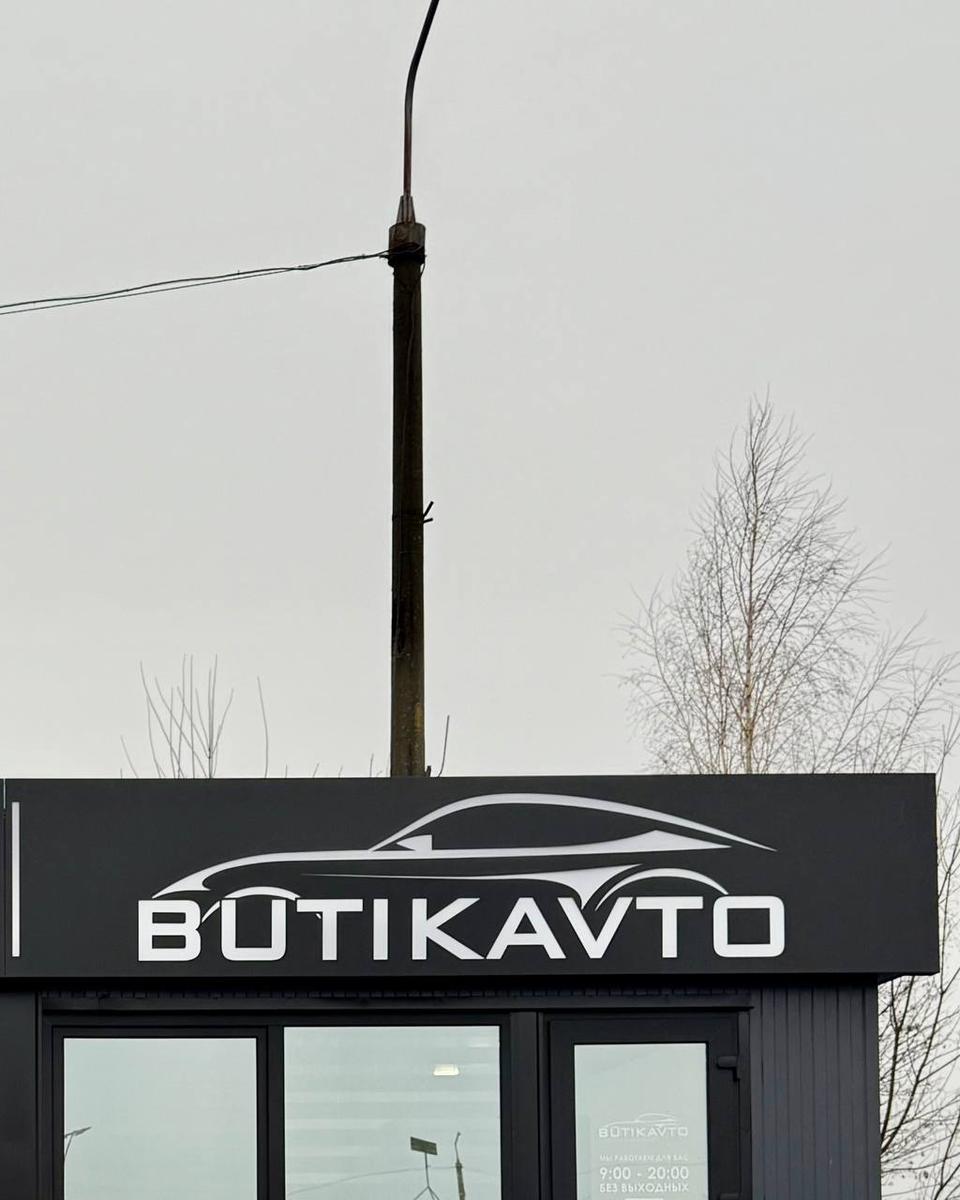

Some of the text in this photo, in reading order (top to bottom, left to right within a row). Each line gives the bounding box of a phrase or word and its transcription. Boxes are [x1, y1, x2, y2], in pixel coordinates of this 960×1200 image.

[138, 895, 786, 962] BUTIKAVTO
[598, 1127, 689, 1138] BUTIKAVTO
[599, 1166, 631, 1180] 9:00
[647, 1166, 689, 1180] 20:00
[599, 1183, 689, 1193] БЕЗ ВЫХОДНЫХ
